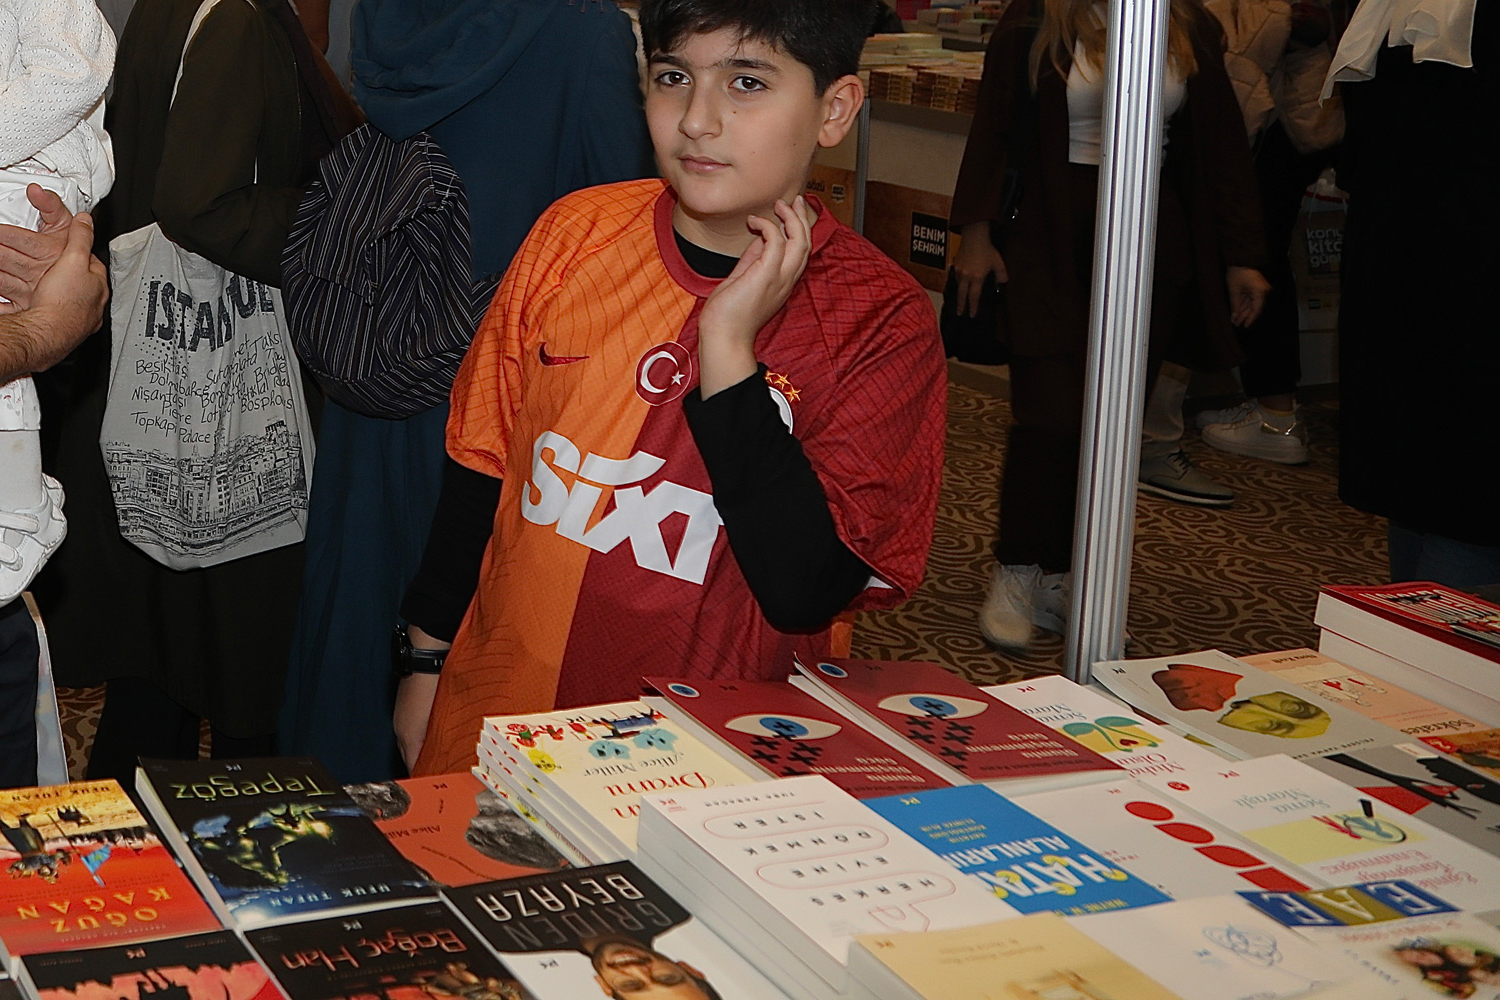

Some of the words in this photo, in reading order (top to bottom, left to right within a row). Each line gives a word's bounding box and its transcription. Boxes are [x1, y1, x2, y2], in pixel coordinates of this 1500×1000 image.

[912, 224, 946, 243] BENİM
[1023, 703, 1072, 715] Mara
[1399, 717, 1476, 736] Sokrates
[582, 761, 637, 778] Miller
[641, 752, 684, 771] Alice
[168, 771, 336, 802] Tepegöz
[1274, 797, 1331, 815] Sema
[411, 824, 441, 835] Alice
[270, 891, 332, 907] TUFAN
[340, 882, 391, 899] UFUK
[475, 873, 645, 922] BEYAZA
[810, 879, 936, 907] HERKES
[16, 886, 172, 920] KAĞAN
[48, 905, 158, 934] OĞUZ
[280, 944, 360, 972] Han
